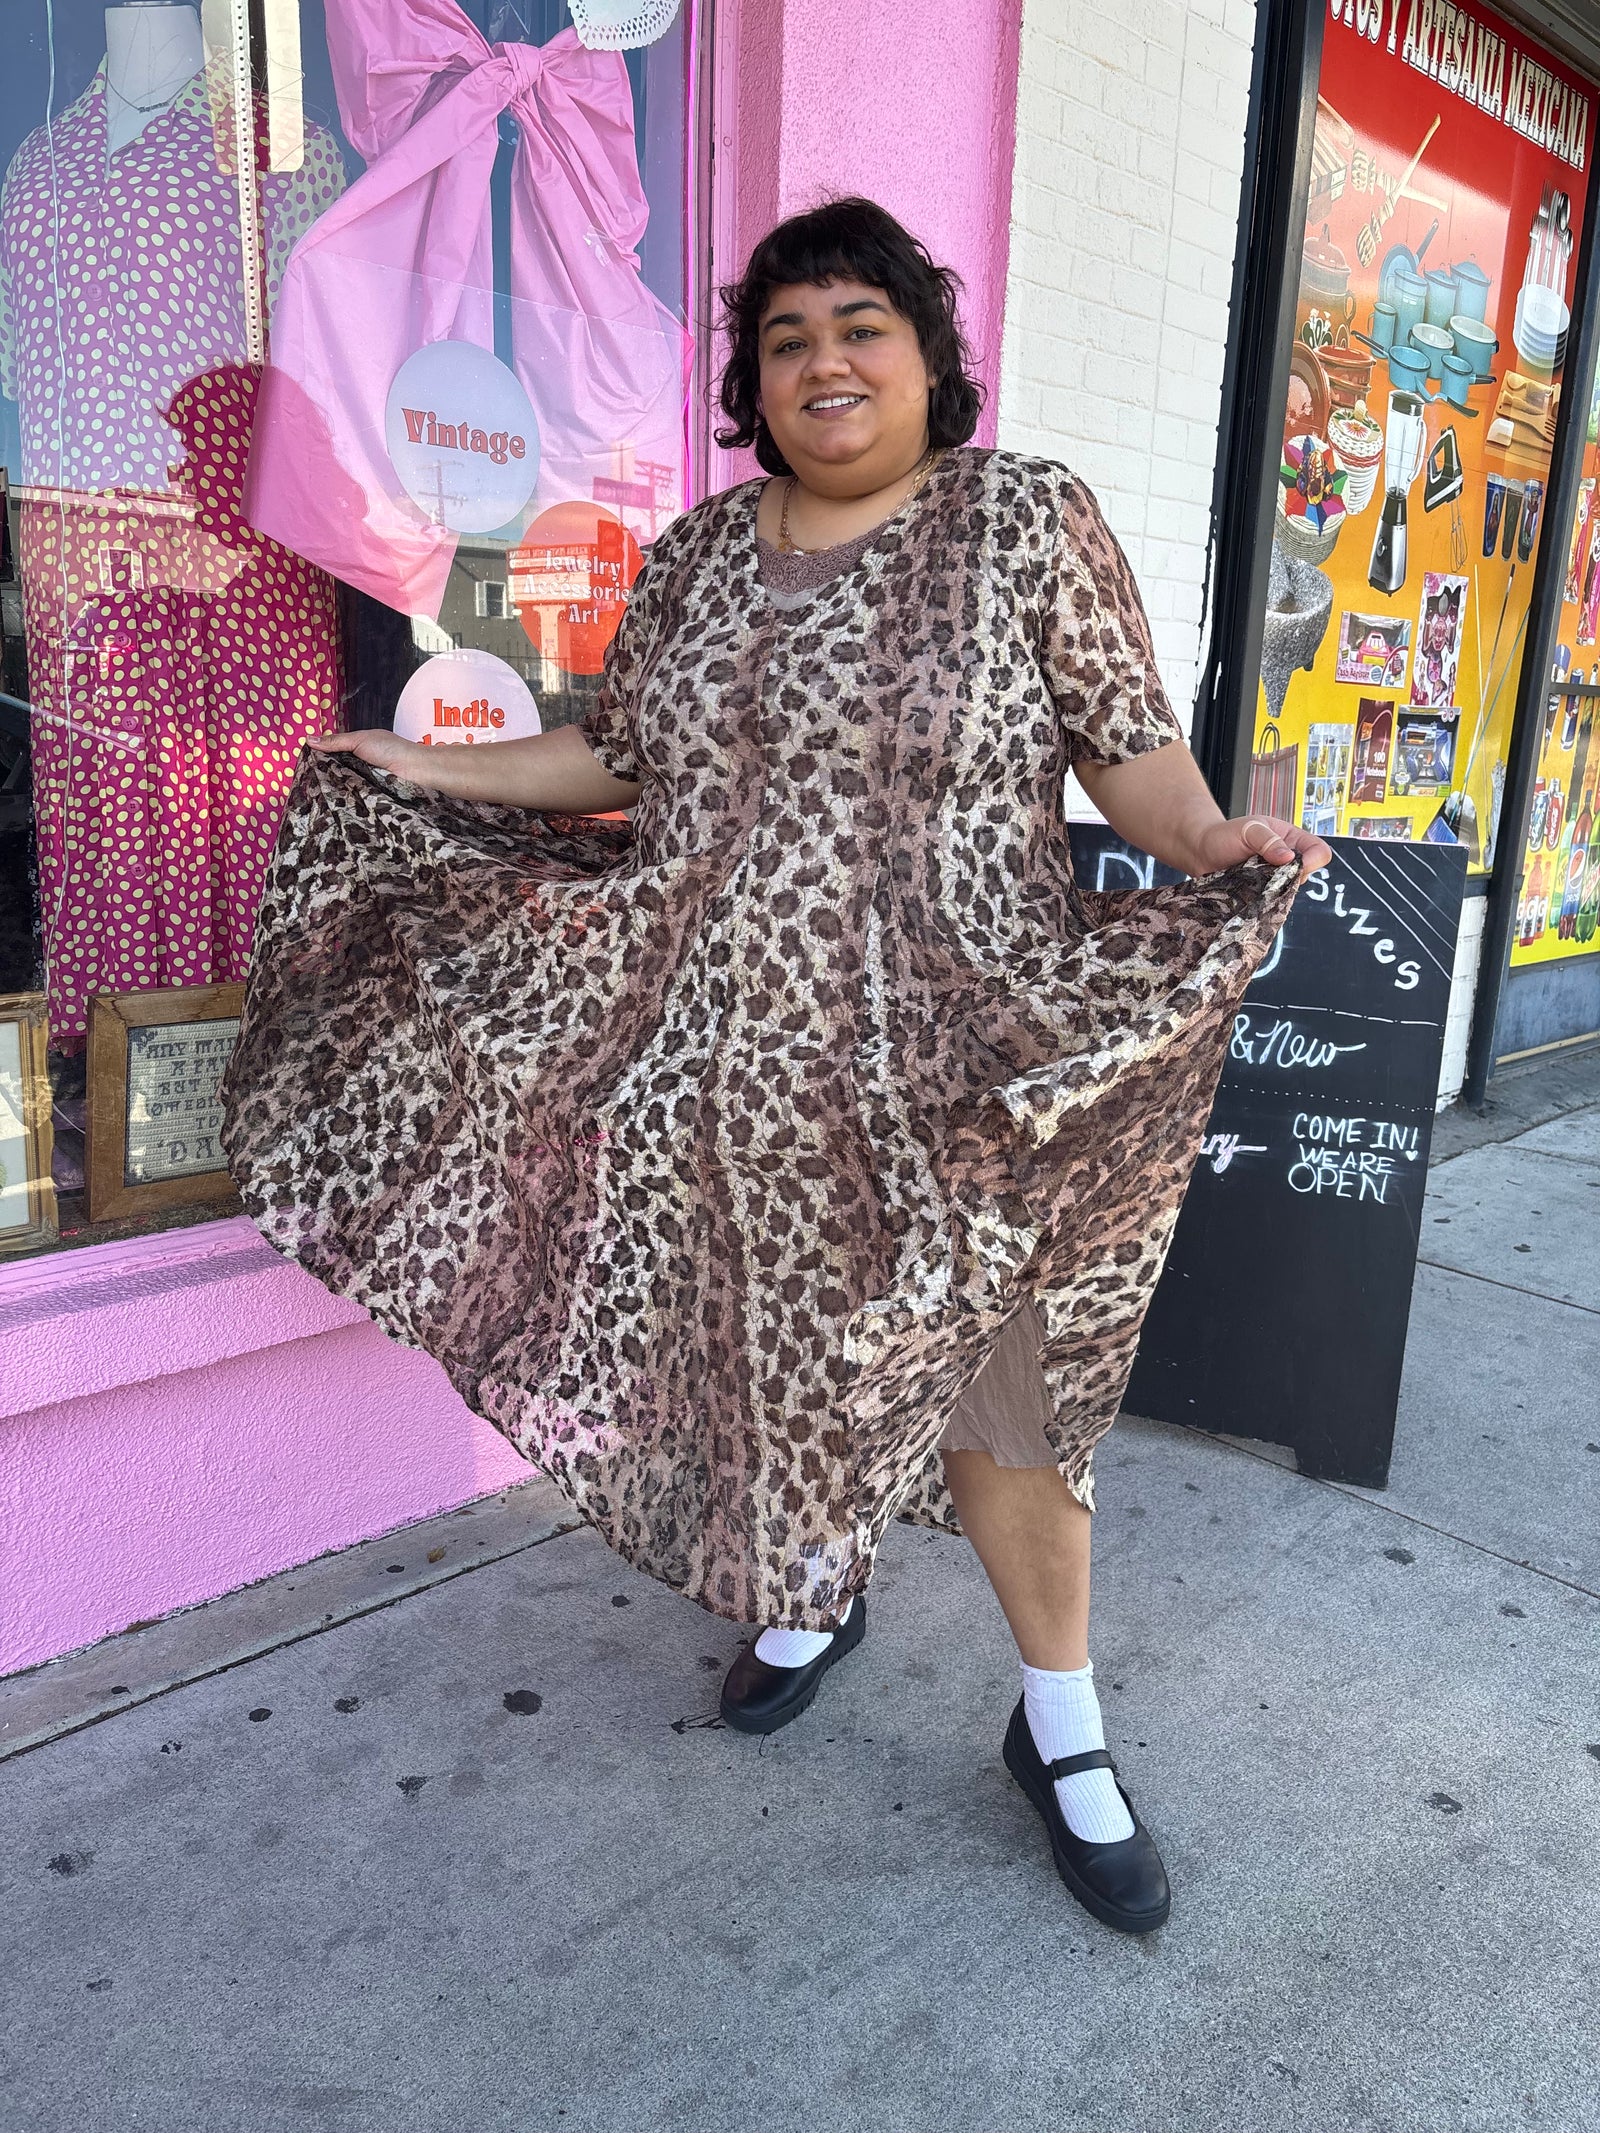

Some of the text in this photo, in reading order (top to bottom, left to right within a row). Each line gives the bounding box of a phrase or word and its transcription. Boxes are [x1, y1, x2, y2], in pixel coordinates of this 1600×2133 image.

[1401, 0, 1507, 122] ARTESANIA
[1503, 47, 1589, 172] MEXICANA
[401, 407, 526, 465] Vintage
[546, 550, 620, 581] Jewelry
[523, 574, 630, 602] Accessorie
[569, 603, 599, 625] Art
[433, 698, 505, 729] Indie
[1373, 751, 1386, 763] 100
[1230, 1014, 1254, 1065] &
[1292, 1113, 1419, 1161] COME IN!
[1299, 1144, 1396, 1176] WE ARE
[1288, 1162, 1389, 1204] OPEN
